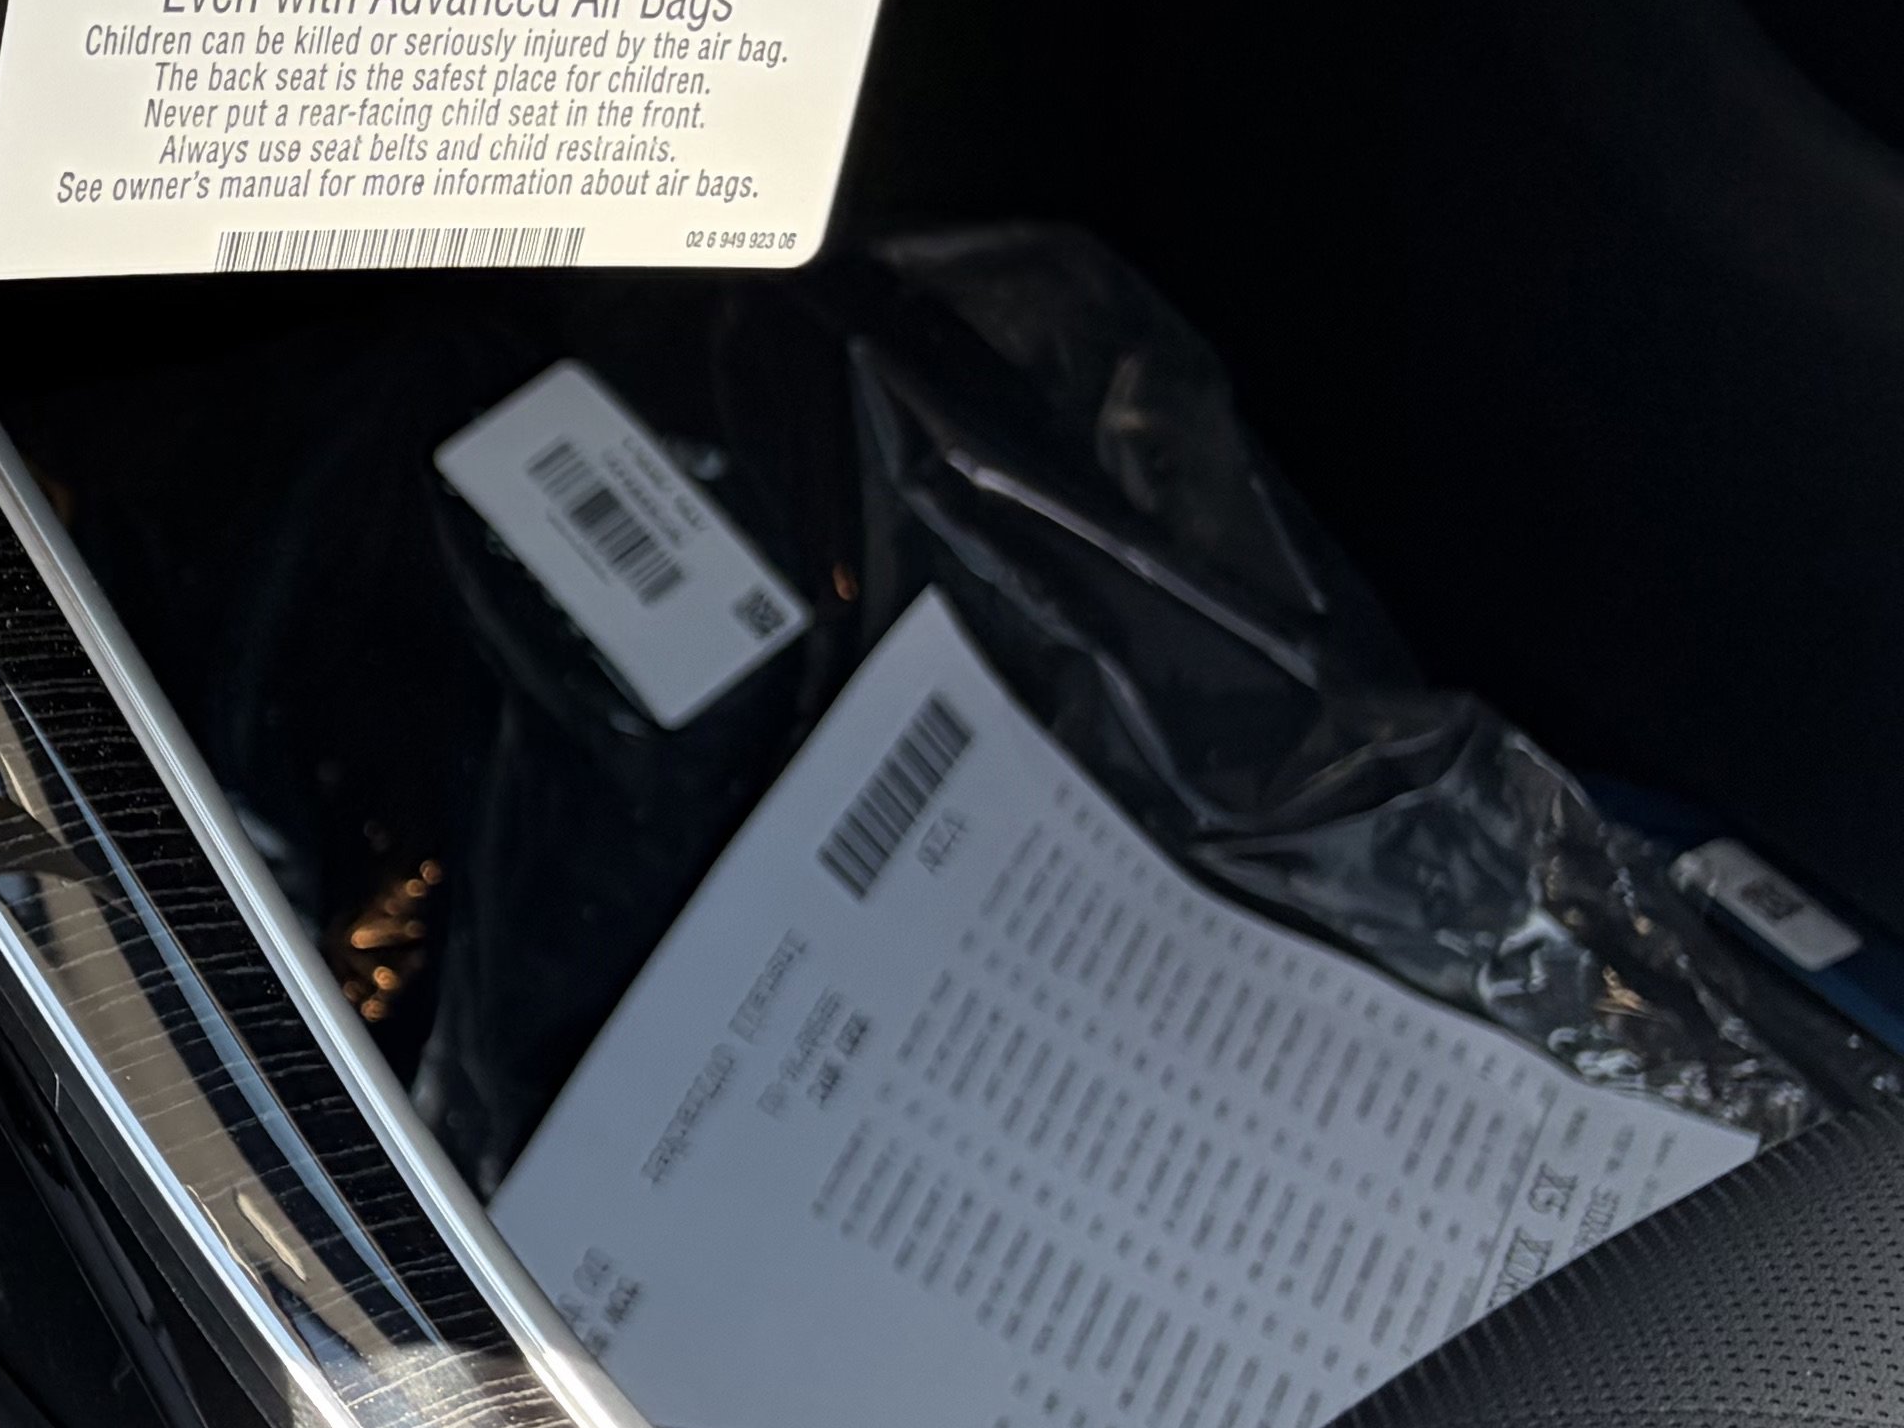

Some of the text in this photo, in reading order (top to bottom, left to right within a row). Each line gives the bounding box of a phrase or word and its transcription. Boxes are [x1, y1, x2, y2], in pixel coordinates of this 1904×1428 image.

[85, 24, 788, 69] Children can be killed or seriously injured by the air bag.
[155, 61, 710, 98] The back seat is the safest place for children.
[144, 97, 704, 134] Never put a rear-facing child seat in the front.
[158, 132, 675, 170] Always use seat belts and child restraints.
[57, 167, 758, 204] See owner's manual for more information about air bags.
[686, 230, 798, 250] 02 6 949 923 06
